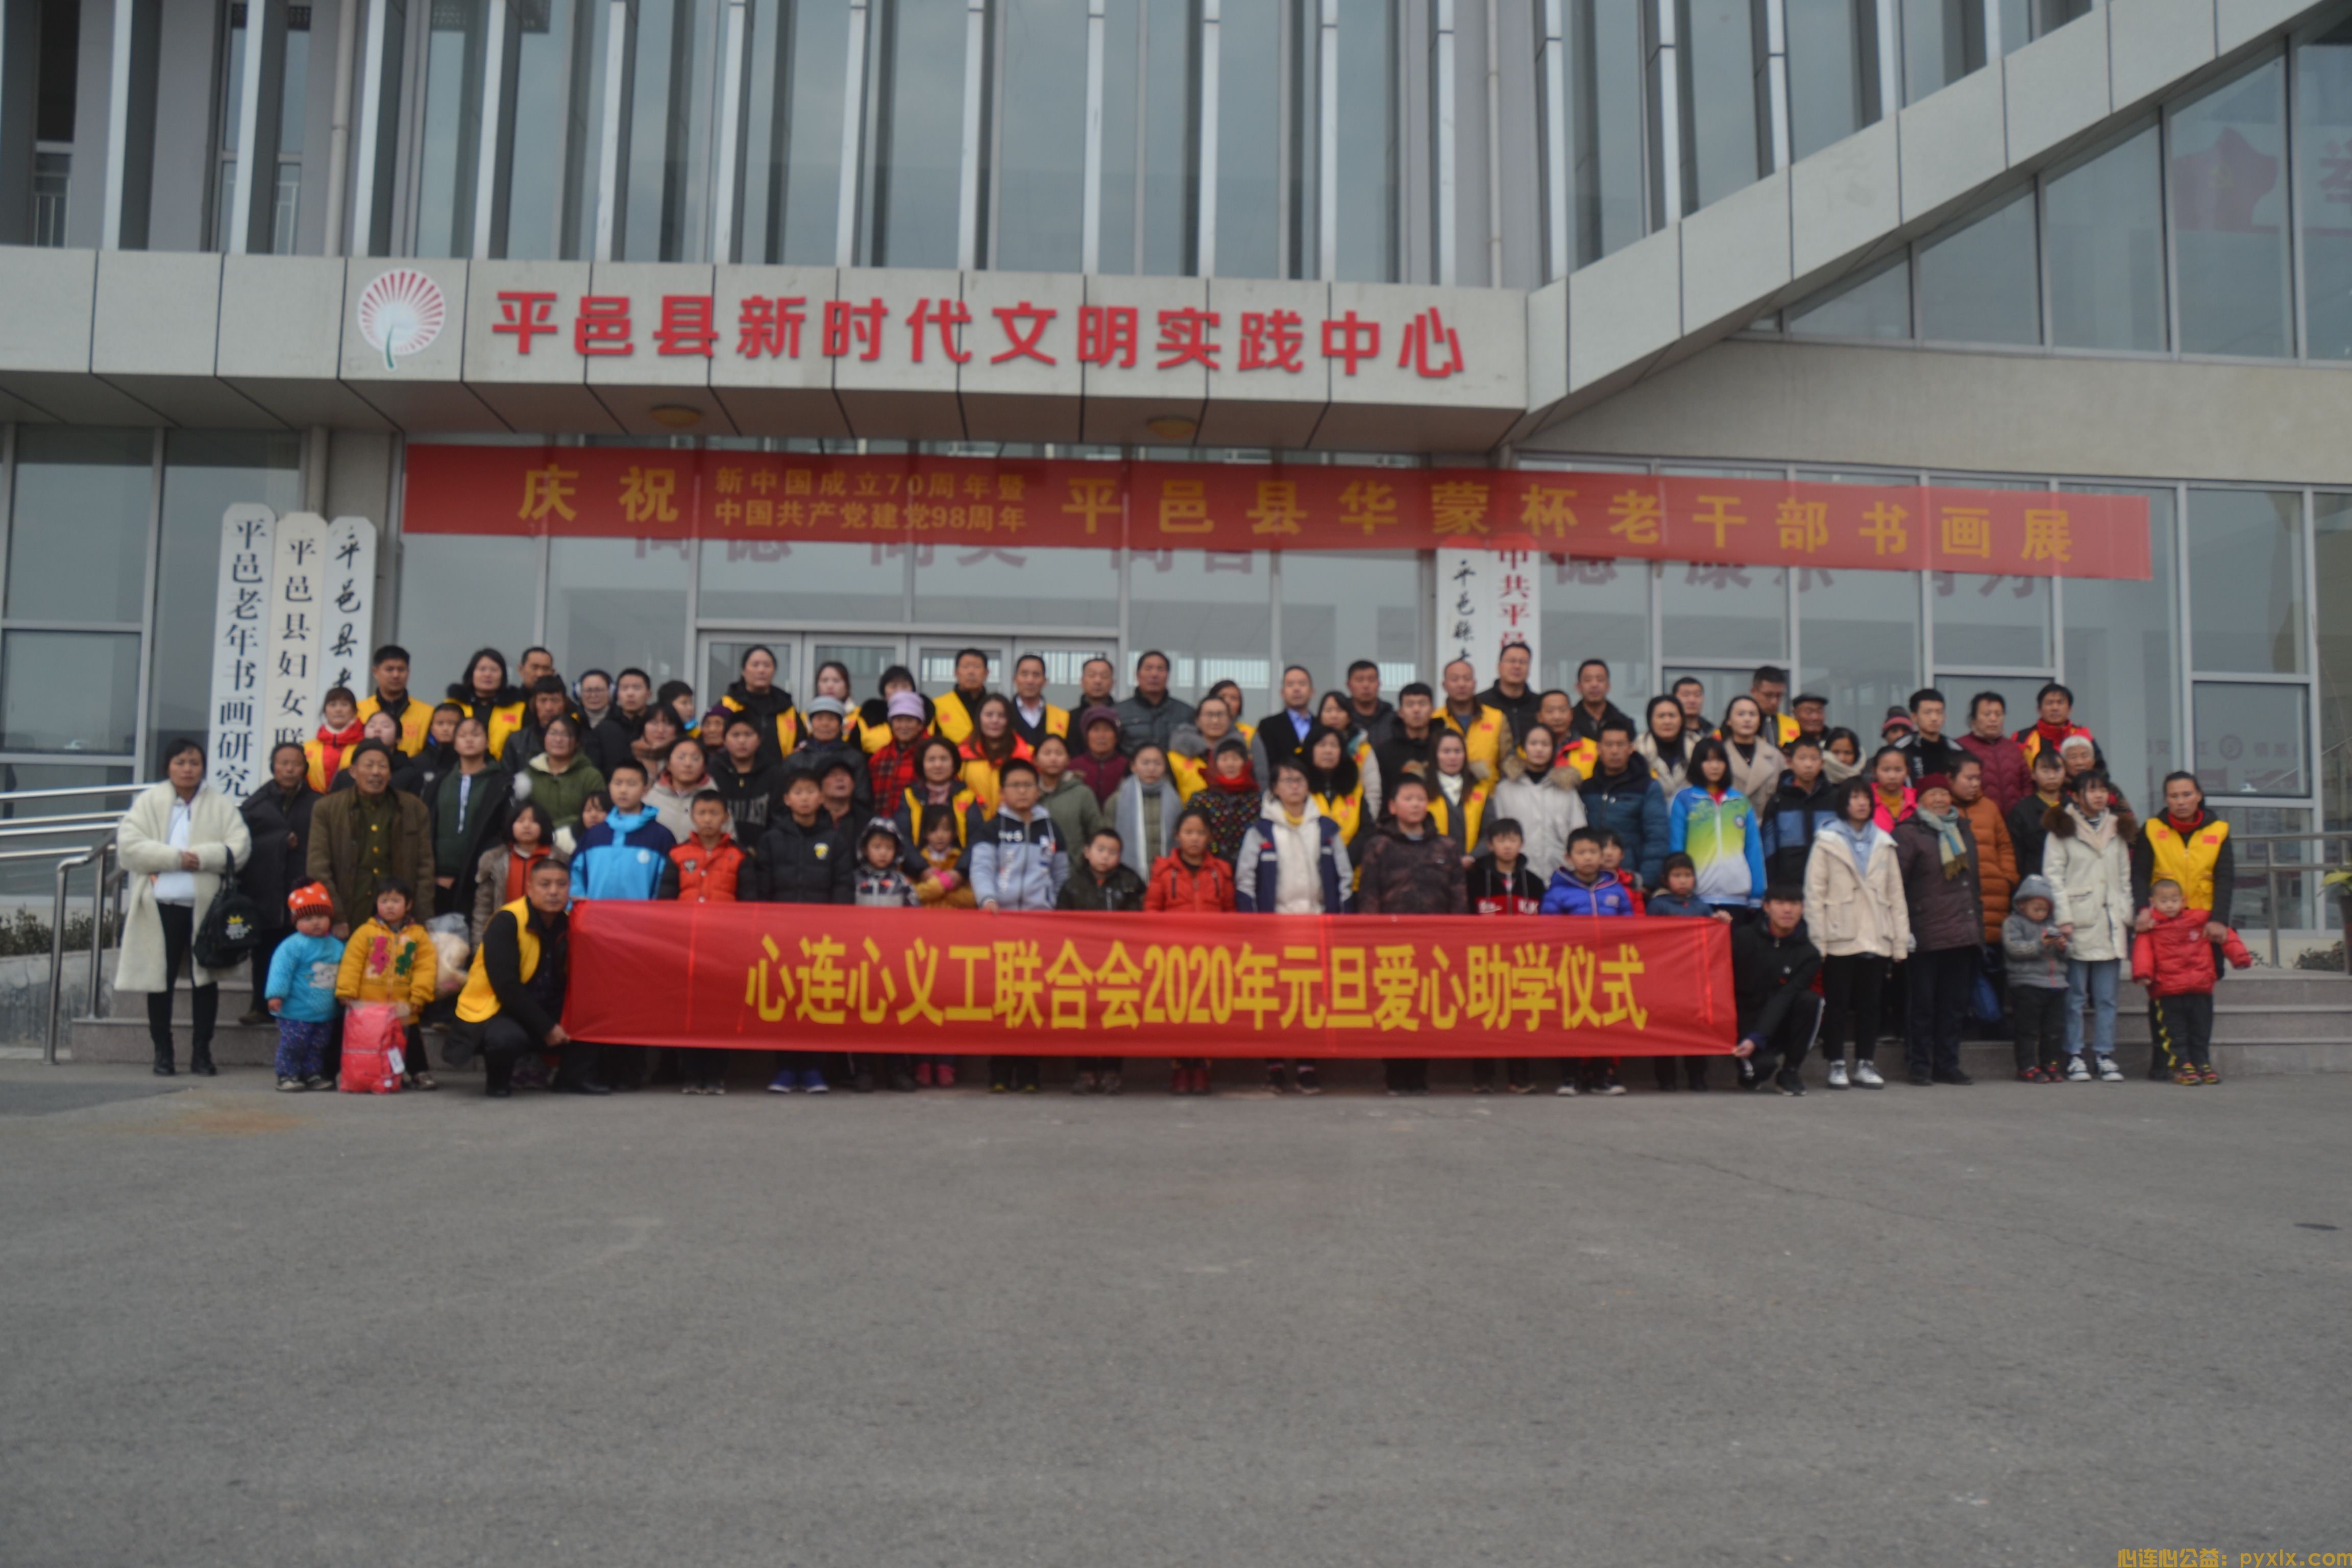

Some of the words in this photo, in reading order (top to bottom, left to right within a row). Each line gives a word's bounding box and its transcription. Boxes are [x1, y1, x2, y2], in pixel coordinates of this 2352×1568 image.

[492, 291, 1464, 378] 平邑县新时代文明实践中心
[518, 464, 679, 523] 庆祝
[715, 498, 1026, 532] 中国共产党建党98周年
[716, 467, 1025, 501] 新中国成立70周年暨
[1061, 477, 2073, 563] 平邑县华蒙杯老干部书画展
[745, 934, 1648, 1032] 心连心义工联合会2020年元旦爱心助学仪式
